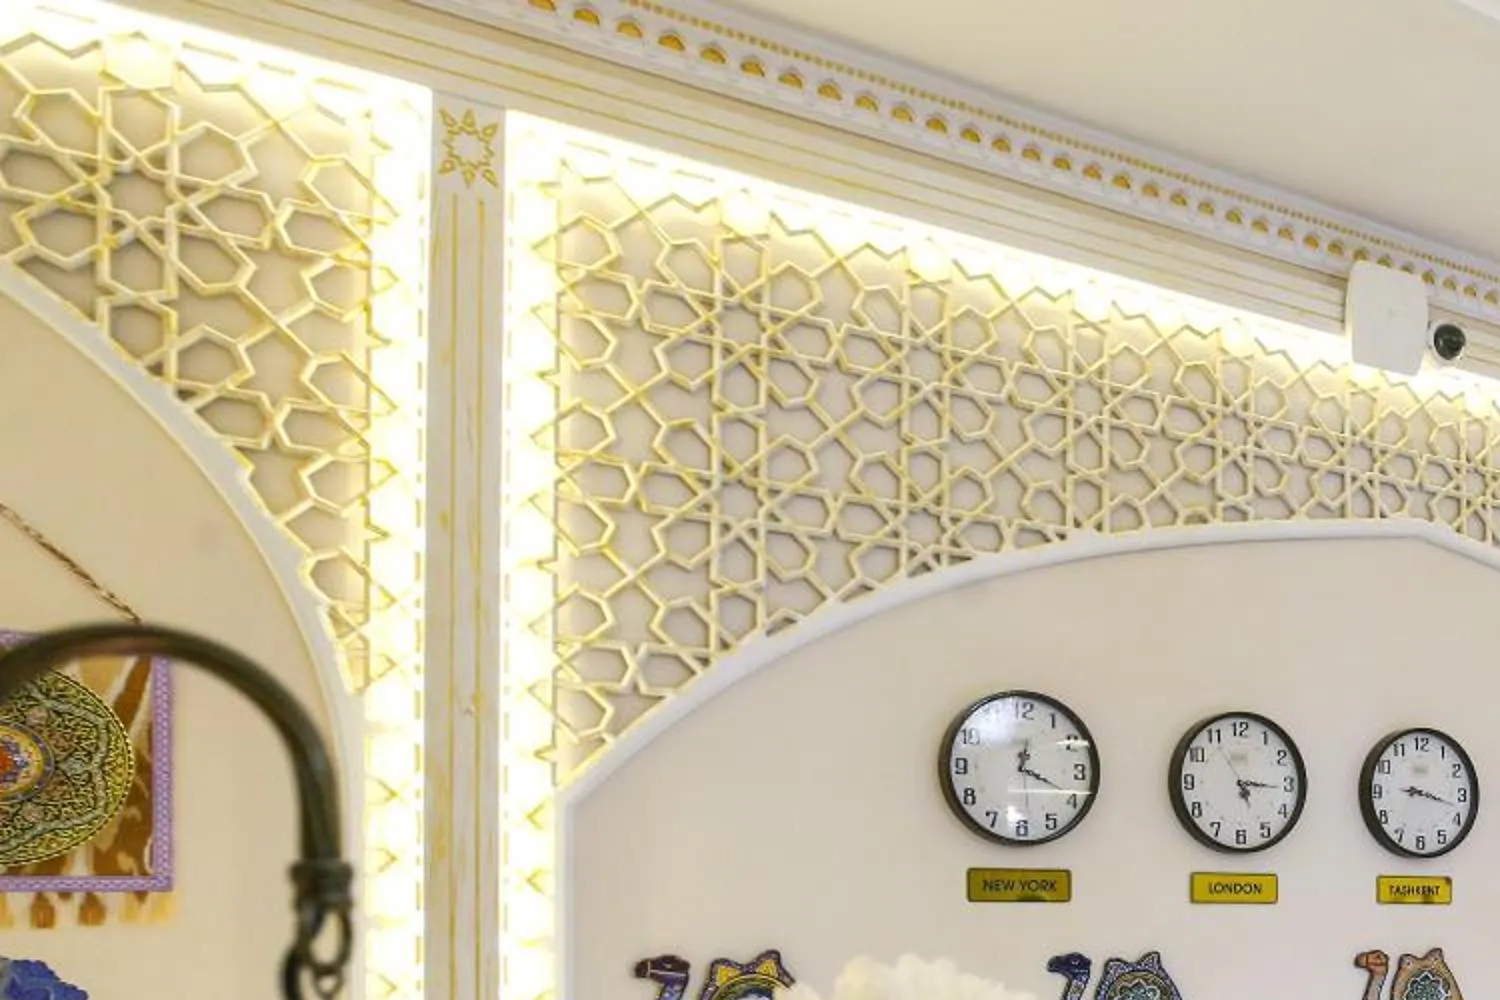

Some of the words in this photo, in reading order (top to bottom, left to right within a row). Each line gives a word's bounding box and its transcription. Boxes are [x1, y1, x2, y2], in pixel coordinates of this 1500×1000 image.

[1050, 714, 1056, 728] 1
[1207, 730, 1221, 744] 11
[1232, 722, 1249, 737] 12
[1262, 731, 1268, 744] 1
[1414, 737, 1429, 752] 12
[1277, 750, 1287, 765] 2
[1441, 746, 1444, 759] 1
[955, 758, 968, 774] 9
[1074, 764, 1085, 780] 3
[1452, 764, 1461, 777] 2
[1184, 774, 1195, 790] 9
[1283, 776, 1294, 792] 3
[964, 788, 976, 804] 8
[1372, 784, 1382, 799] 9
[1458, 788, 1466, 802] 3
[1067, 794, 1077, 808] 4
[1191, 802, 1202, 817] 8
[1278, 804, 1287, 818] 4
[1379, 810, 1388, 824] 8
[986, 811, 998, 828] 7
[1045, 813, 1057, 829] 5
[1016, 820, 1028, 836] 6
[1210, 822, 1221, 837] 7
[1260, 822, 1271, 838] 5
[1236, 830, 1246, 844] 6
[1416, 836, 1425, 850] 6
[1437, 830, 1446, 844] 5
[982, 879, 1015, 892] NEW
[1019, 879, 1057, 892] YORK
[1208, 882, 1263, 895] LONDON
